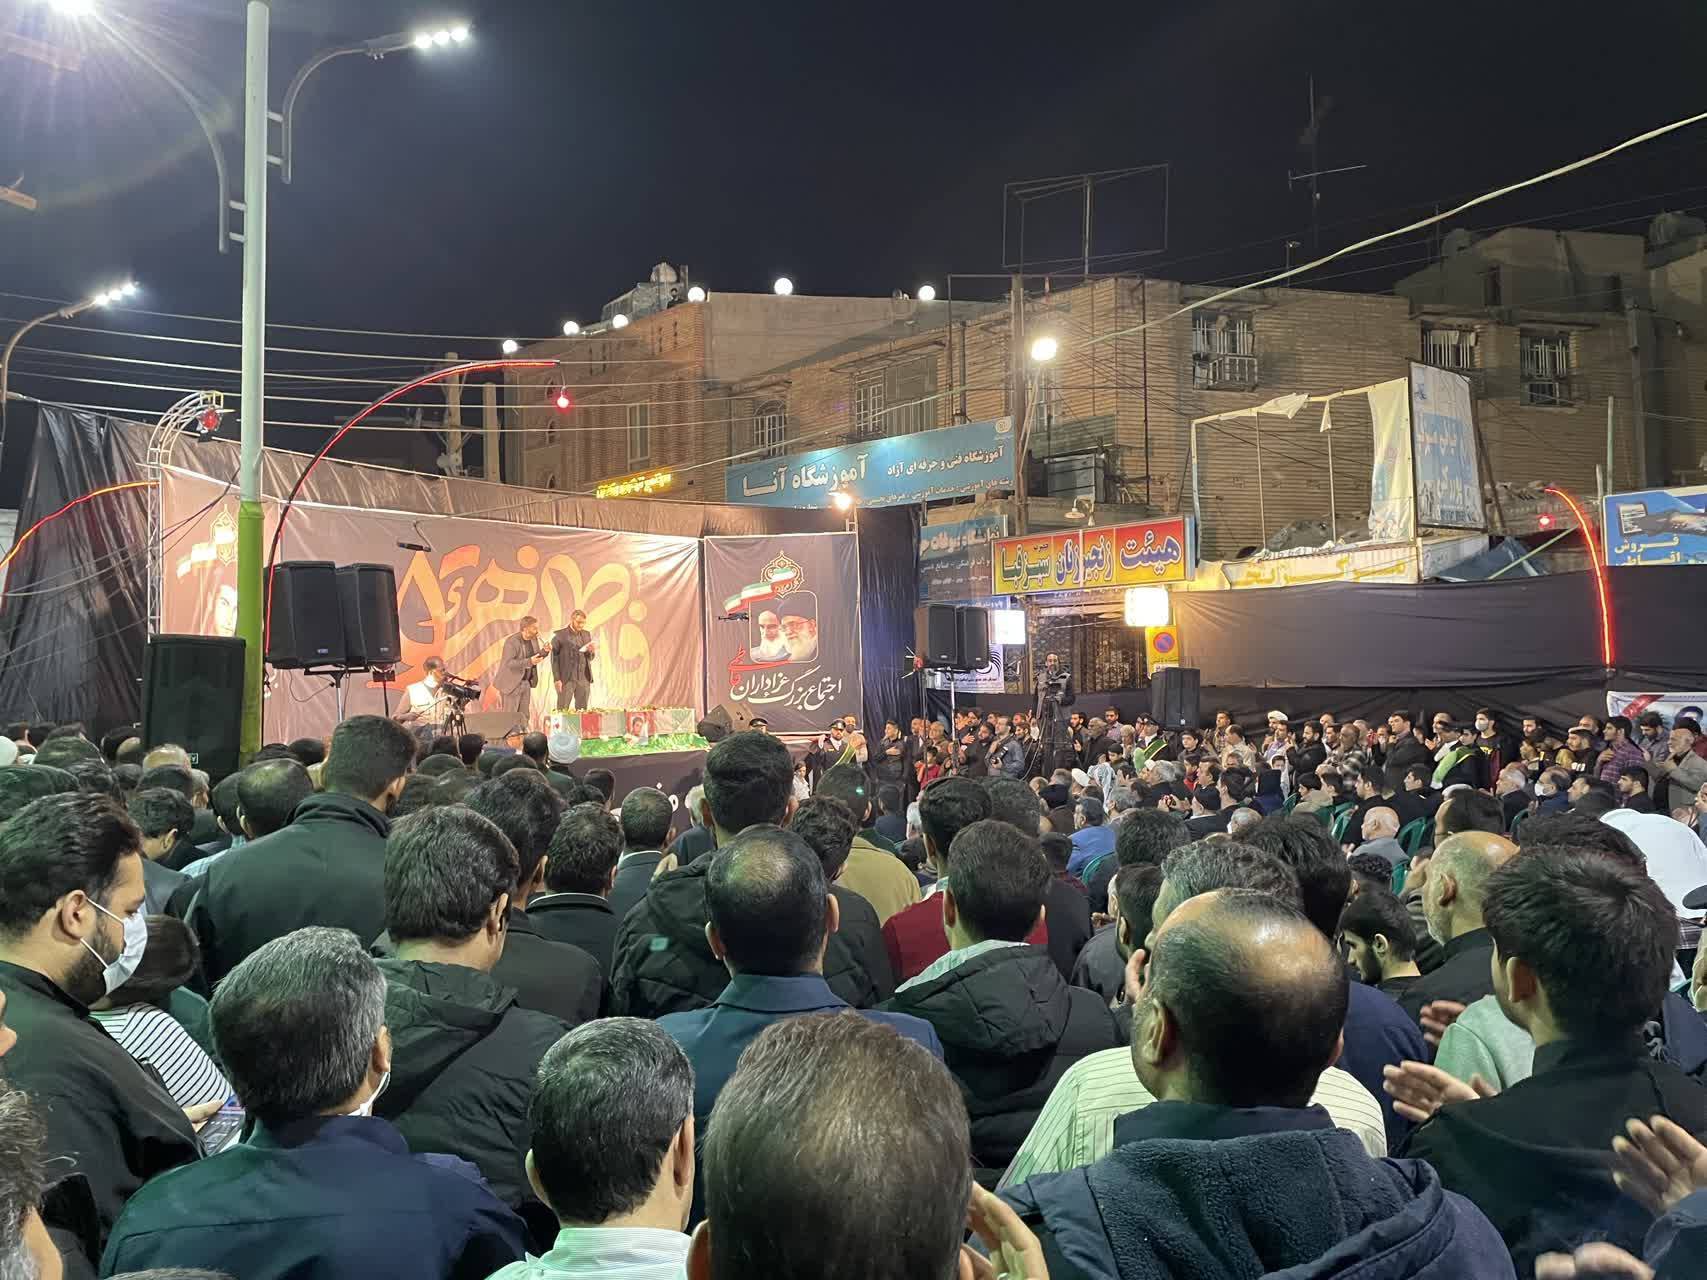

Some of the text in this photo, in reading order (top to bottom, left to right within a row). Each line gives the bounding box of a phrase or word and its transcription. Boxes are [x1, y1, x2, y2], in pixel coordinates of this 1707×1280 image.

[919, 460, 939, 473] حرفه
[946, 454, 963, 469] فنی
[964, 445, 1004, 464] آموزشگاه
[791, 453, 869, 494] آموزشگاه
[887, 460, 904, 477] آزاد
[1120, 529, 1182, 576] هیئت
[1614, 533, 1680, 554] فروش
[730, 672, 790, 700] عزاداران
[747, 665, 821, 710] بزرگ
[804, 676, 842, 711] اجتماع
